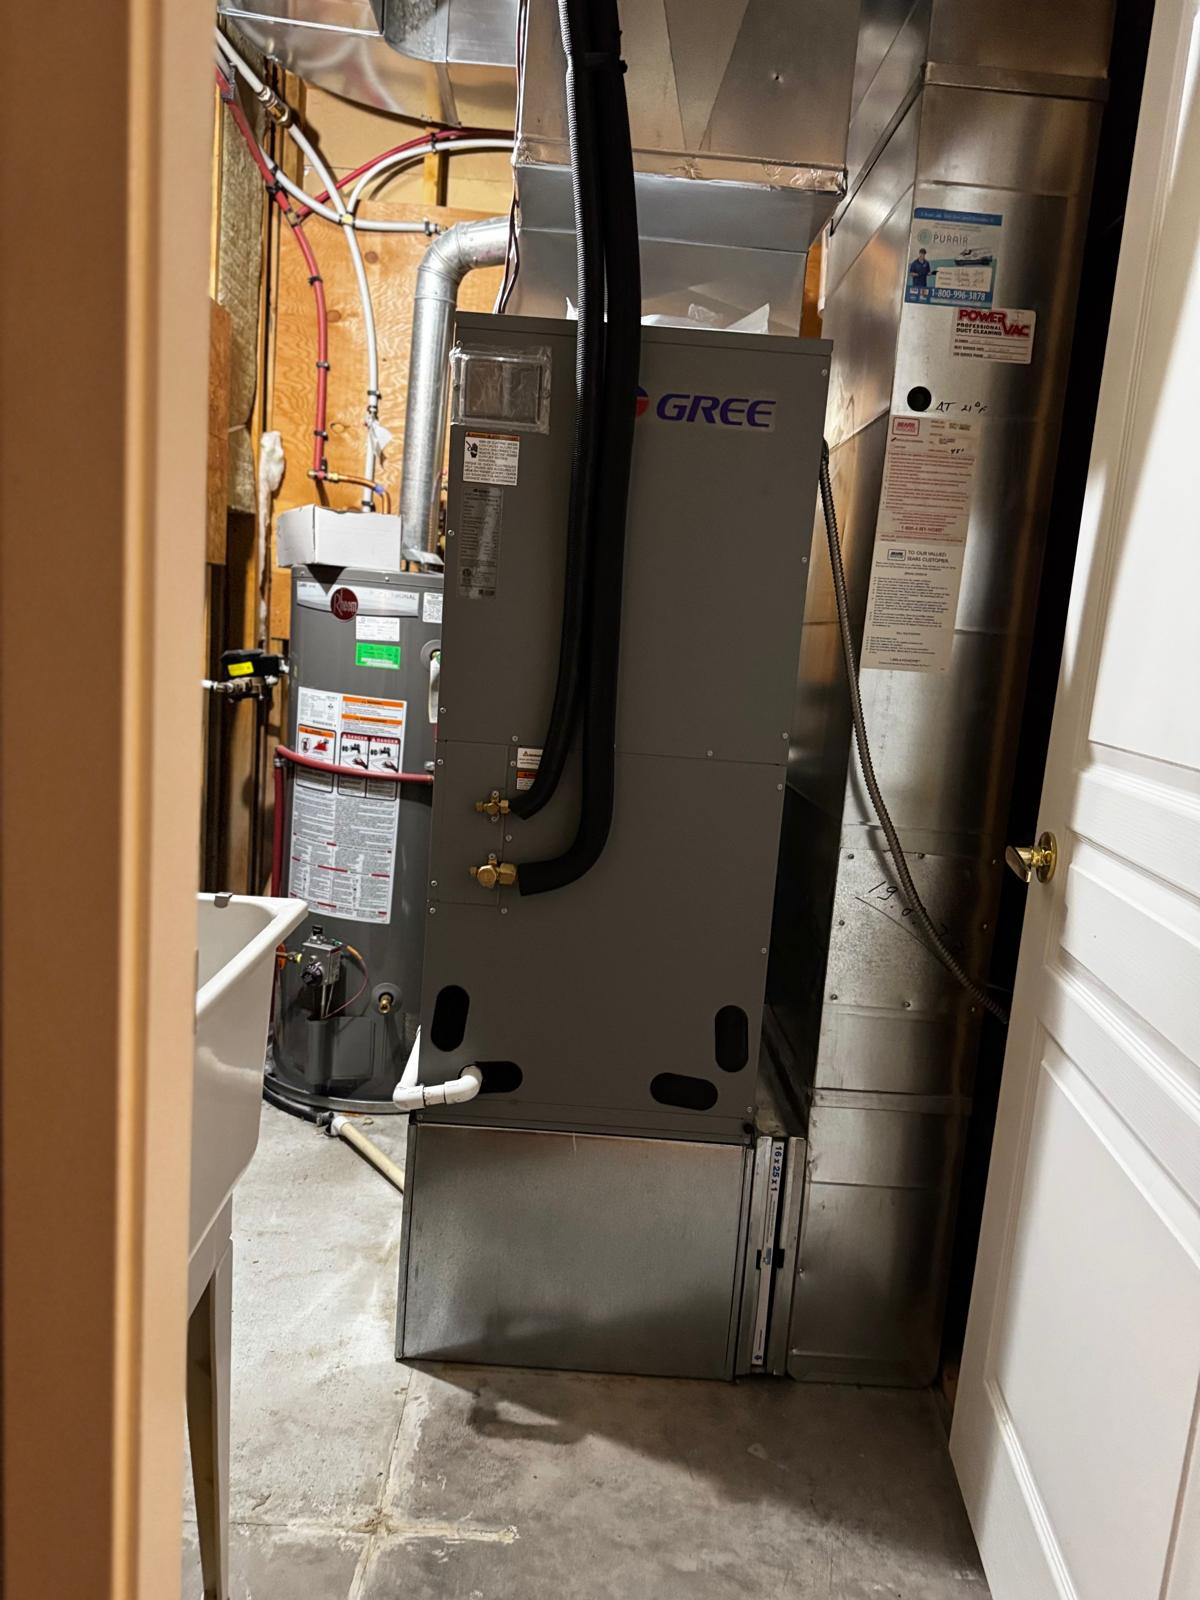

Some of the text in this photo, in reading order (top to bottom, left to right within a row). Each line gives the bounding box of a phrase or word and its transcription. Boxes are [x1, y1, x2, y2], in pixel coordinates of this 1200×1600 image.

[958, 309, 1007, 323] POWER
[956, 322, 1001, 331] PROFESSIONAL
[1003, 321, 1031, 337] VAC
[656, 393, 777, 428] GREE
[774, 1146, 782, 1157] 16
[772, 1166, 780, 1178] 25
